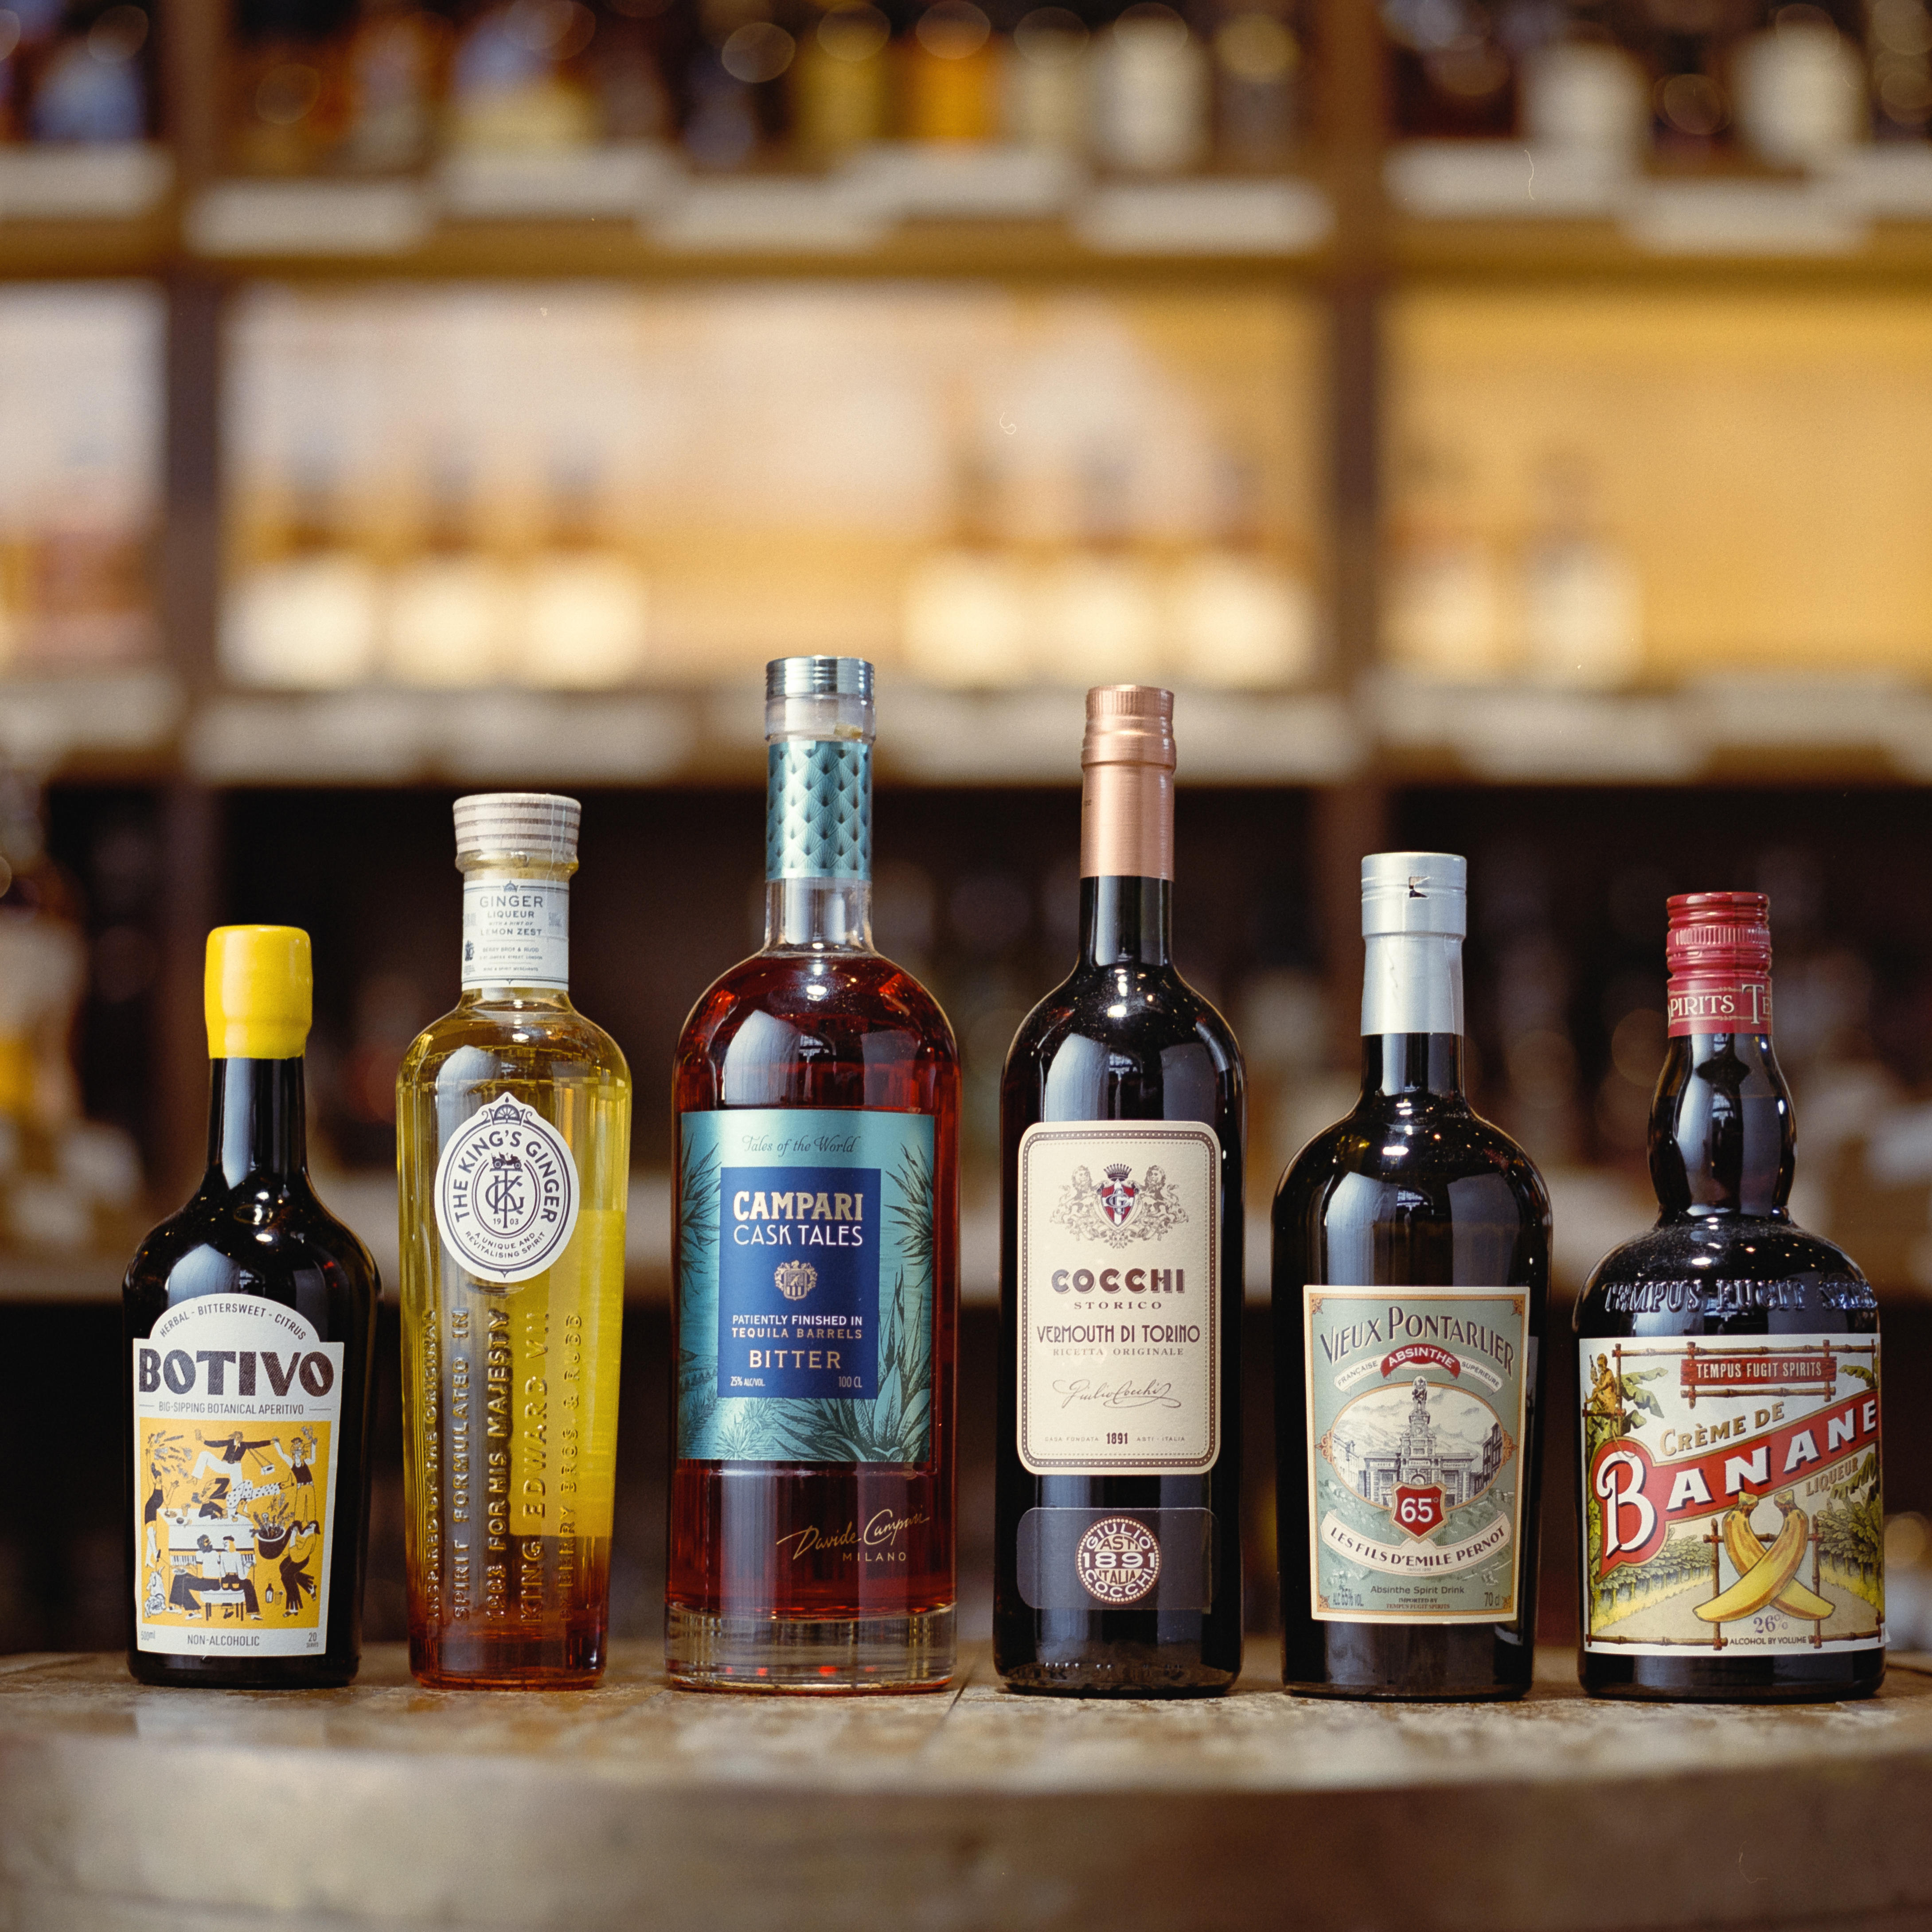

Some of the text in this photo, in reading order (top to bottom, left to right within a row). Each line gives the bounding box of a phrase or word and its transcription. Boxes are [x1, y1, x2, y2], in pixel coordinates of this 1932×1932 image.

[480, 896, 543, 908] GINGER
[1668, 995, 1735, 1028] PIRITS
[742, 1134, 861, 1157] Tales of the World
[453, 1130, 559, 1223] THE KING'S GINGER
[733, 1191, 863, 1222] CAMPARI
[465, 1231, 545, 1258] REVITALISING SPIRIT
[482, 1238, 515, 1250] UNIQUE
[519, 1232, 535, 1246] AND
[734, 1224, 863, 1246] CASK TALES
[1051, 1268, 1185, 1294] COCCHI
[1074, 1301, 1162, 1309] STORICO
[160, 1303, 306, 1340] HERBAL BITTERSWEET CITRUS
[732, 1315, 863, 1325] PATIENTLY FINISHED IN
[732, 1328, 862, 1339] TEQUILA BARRELS
[1037, 1324, 1200, 1343] VERMOUTH DI TORINO
[1320, 1306, 1515, 1380] VIEUX PONTARLIER
[563, 1314, 582, 1383] RUDD
[749, 1350, 841, 1368] BITTER
[1053, 1348, 1184, 1356] RICETTA ORIGINALE
[1388, 1347, 1456, 1368] ABSINTHE
[139, 1348, 334, 1397] BOTIVO
[1337, 1360, 1500, 1387] FRANÇAISE SUPÉRIEURE
[1696, 1362, 1822, 1378] TEMPUS FUGIT SPIRITS
[839, 1376, 863, 1388] 100 CL
[159, 1402, 304, 1414] BIG-SIPPING BOTANICAL APERITIVO
[563, 1394, 579, 1410] &
[1106, 1432, 1128, 1445] 1891
[1659, 1401, 1784, 1457] CRÈME DE
[452, 1309, 469, 1621] SPIRIT FORMULATED IN
[486, 1308, 509, 1621] 1903 FOR HIS MAJESTY
[521, 1312, 549, 1623] KING EDWARD VII
[1596, 1399, 1877, 1558] BANANE
[1805, 1457, 1858, 1497] LIQUEUR
[558, 1506, 575, 1587] BERRY
[1086, 1523, 1151, 1550] GIULIO
[1100, 1536, 1138, 1550] ASTI
[1331, 1525, 1506, 1567] LES FILS D'EMILE PERNOT
[843, 1552, 907, 1562] MILANO
[1082, 1552, 1155, 1568] 1891
[1085, 1567, 1154, 1597] COCCHI
[1099, 1570, 1136, 1585] ITALIA
[1370, 1585, 1464, 1595] Absinthe Spirit Drink
[1484, 1592, 1494, 1607] 70
[1753, 1614, 1788, 1634] 26%
[187, 1635, 260, 1647] NON-ALCOHOLIC
[308, 1632, 317, 1642] 20
